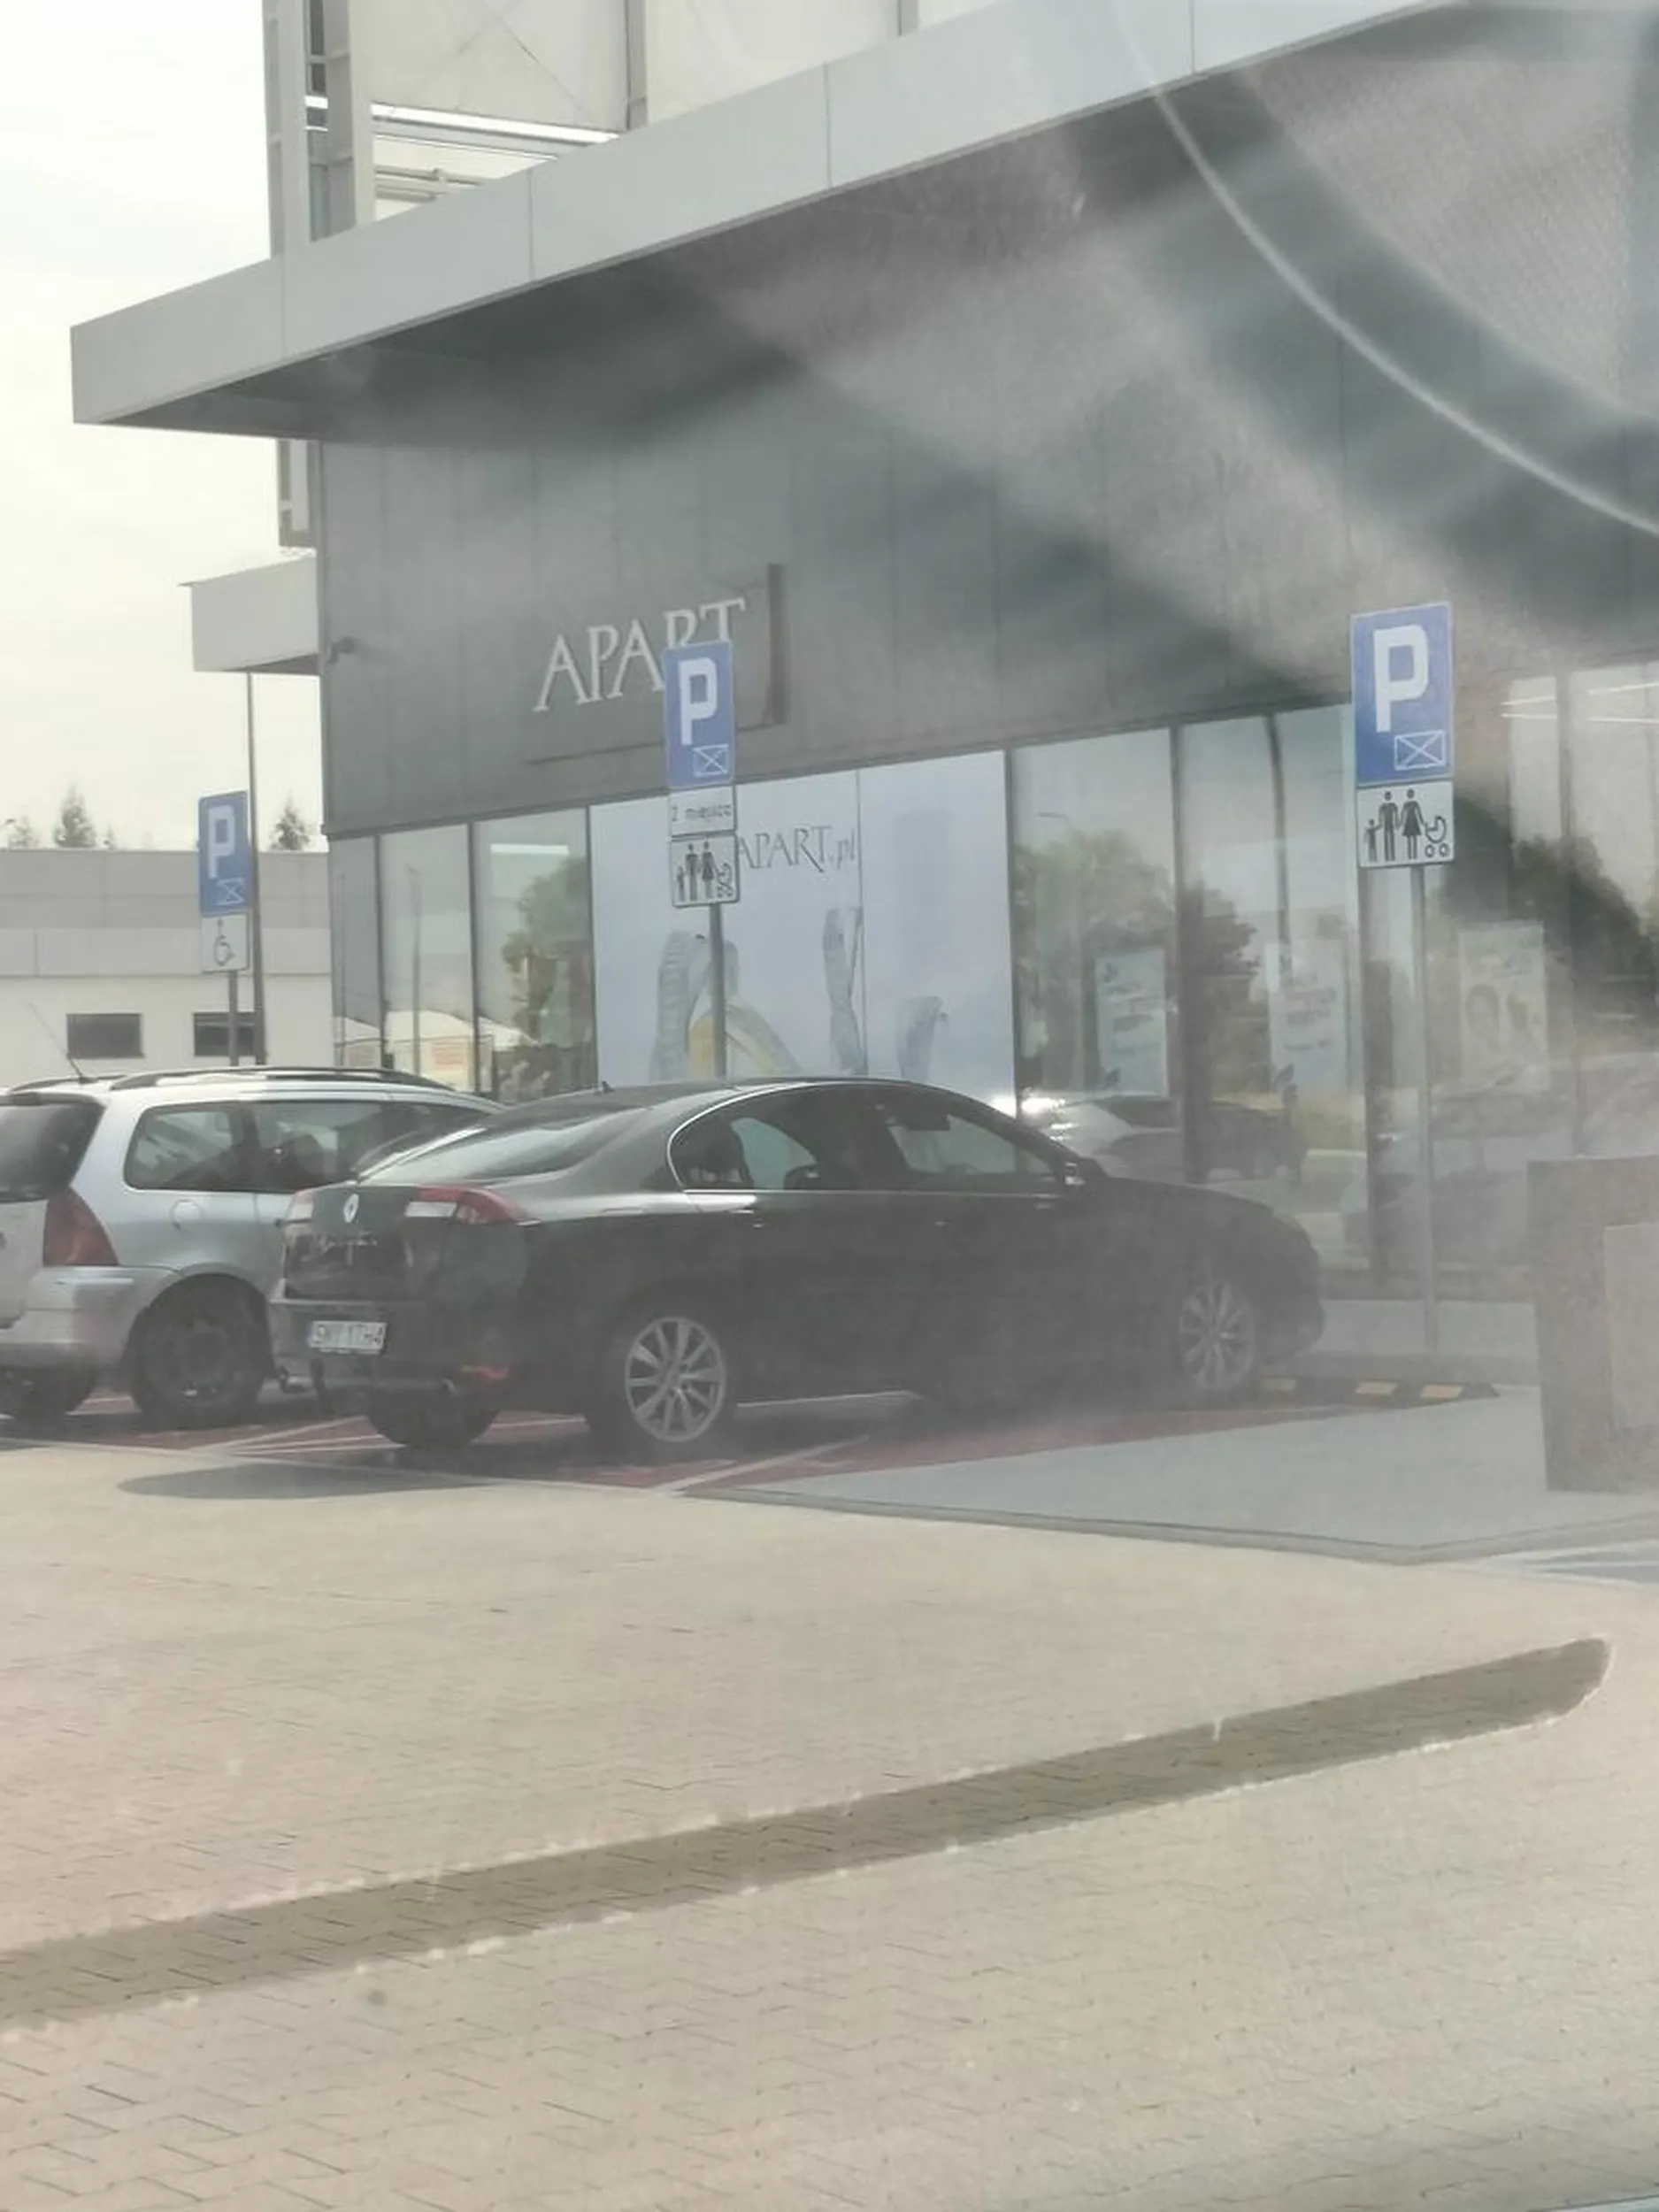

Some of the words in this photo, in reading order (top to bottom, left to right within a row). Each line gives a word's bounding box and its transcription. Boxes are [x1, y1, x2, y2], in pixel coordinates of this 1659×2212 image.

[533, 597, 746, 712] APART
[678, 657, 718, 745] P
[1373, 625, 1428, 733] P
[208, 805, 235, 879] P
